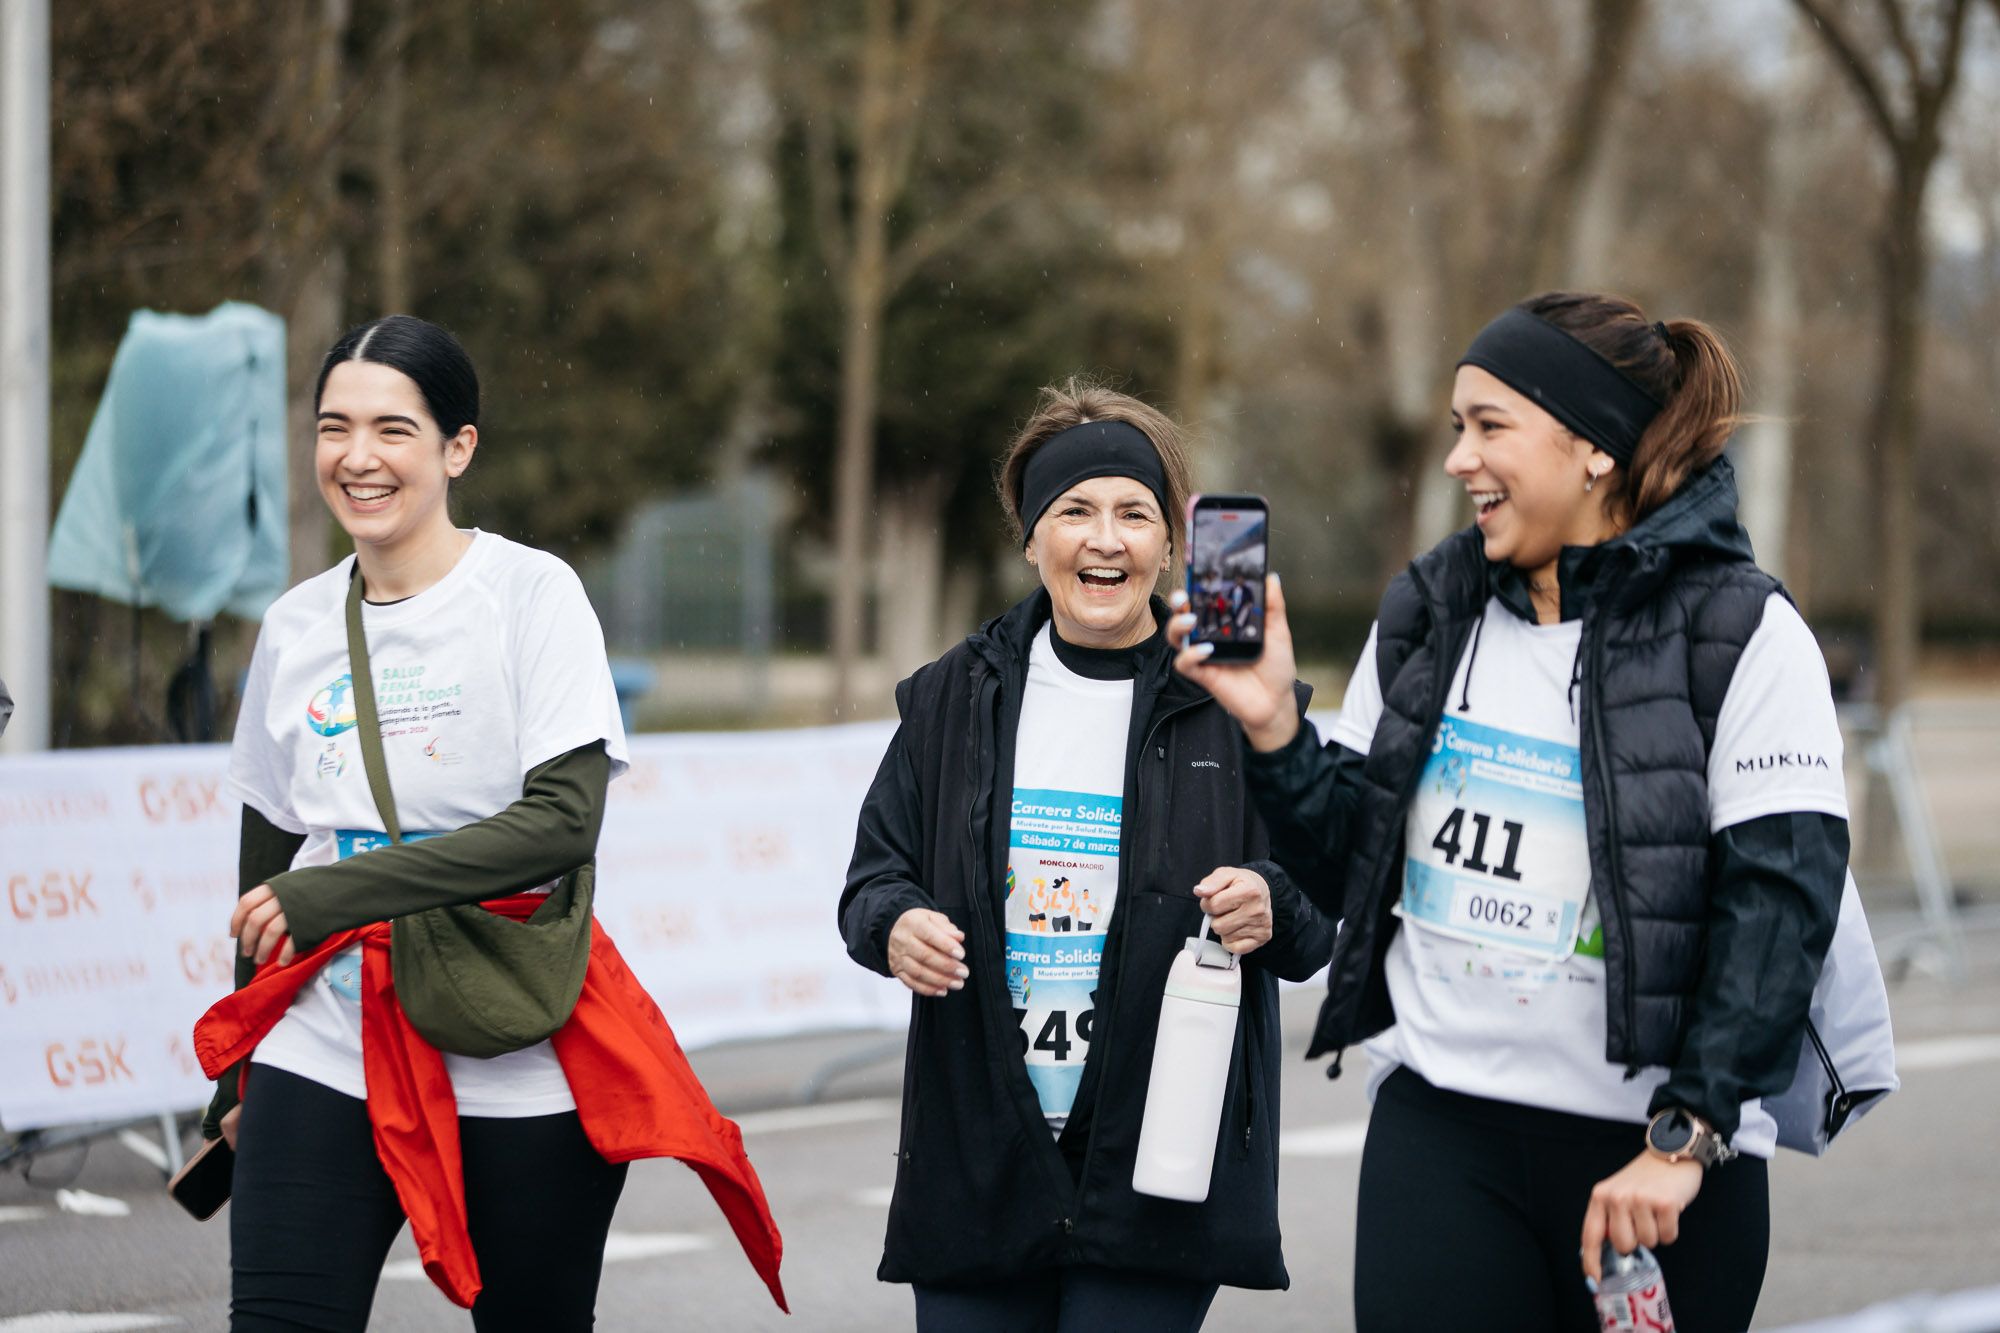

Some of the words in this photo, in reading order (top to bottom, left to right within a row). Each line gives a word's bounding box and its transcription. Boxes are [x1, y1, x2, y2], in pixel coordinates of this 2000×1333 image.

[383, 666, 425, 680] SALUD
[378, 693, 414, 705] PARA
[418, 684, 462, 702] TODOS
[379, 680, 422, 692] RENAL
[1446, 730, 1494, 759] Carrera
[1496, 743, 1572, 778] Solidaria
[1736, 753, 1829, 773] MUKUA
[138, 774, 230, 823] GSK
[1011, 800, 1072, 818] Carrera
[1051, 824, 1063, 832] por
[1076, 825, 1096, 834] Salud
[1021, 834, 1061, 848] Sábado
[1063, 838, 1071, 849] 7
[1072, 839, 1085, 850] de
[1088, 842, 1120, 853] marzo
[1432, 807, 1524, 881] 411
[1039, 859, 1077, 868] MONCLOA
[1079, 862, 1104, 871] MADRID
[8, 872, 98, 920] GSK
[1469, 895, 1533, 930] 0062
[1005, 946, 1051, 964] Carrera
[46, 1036, 135, 1088] GSK
